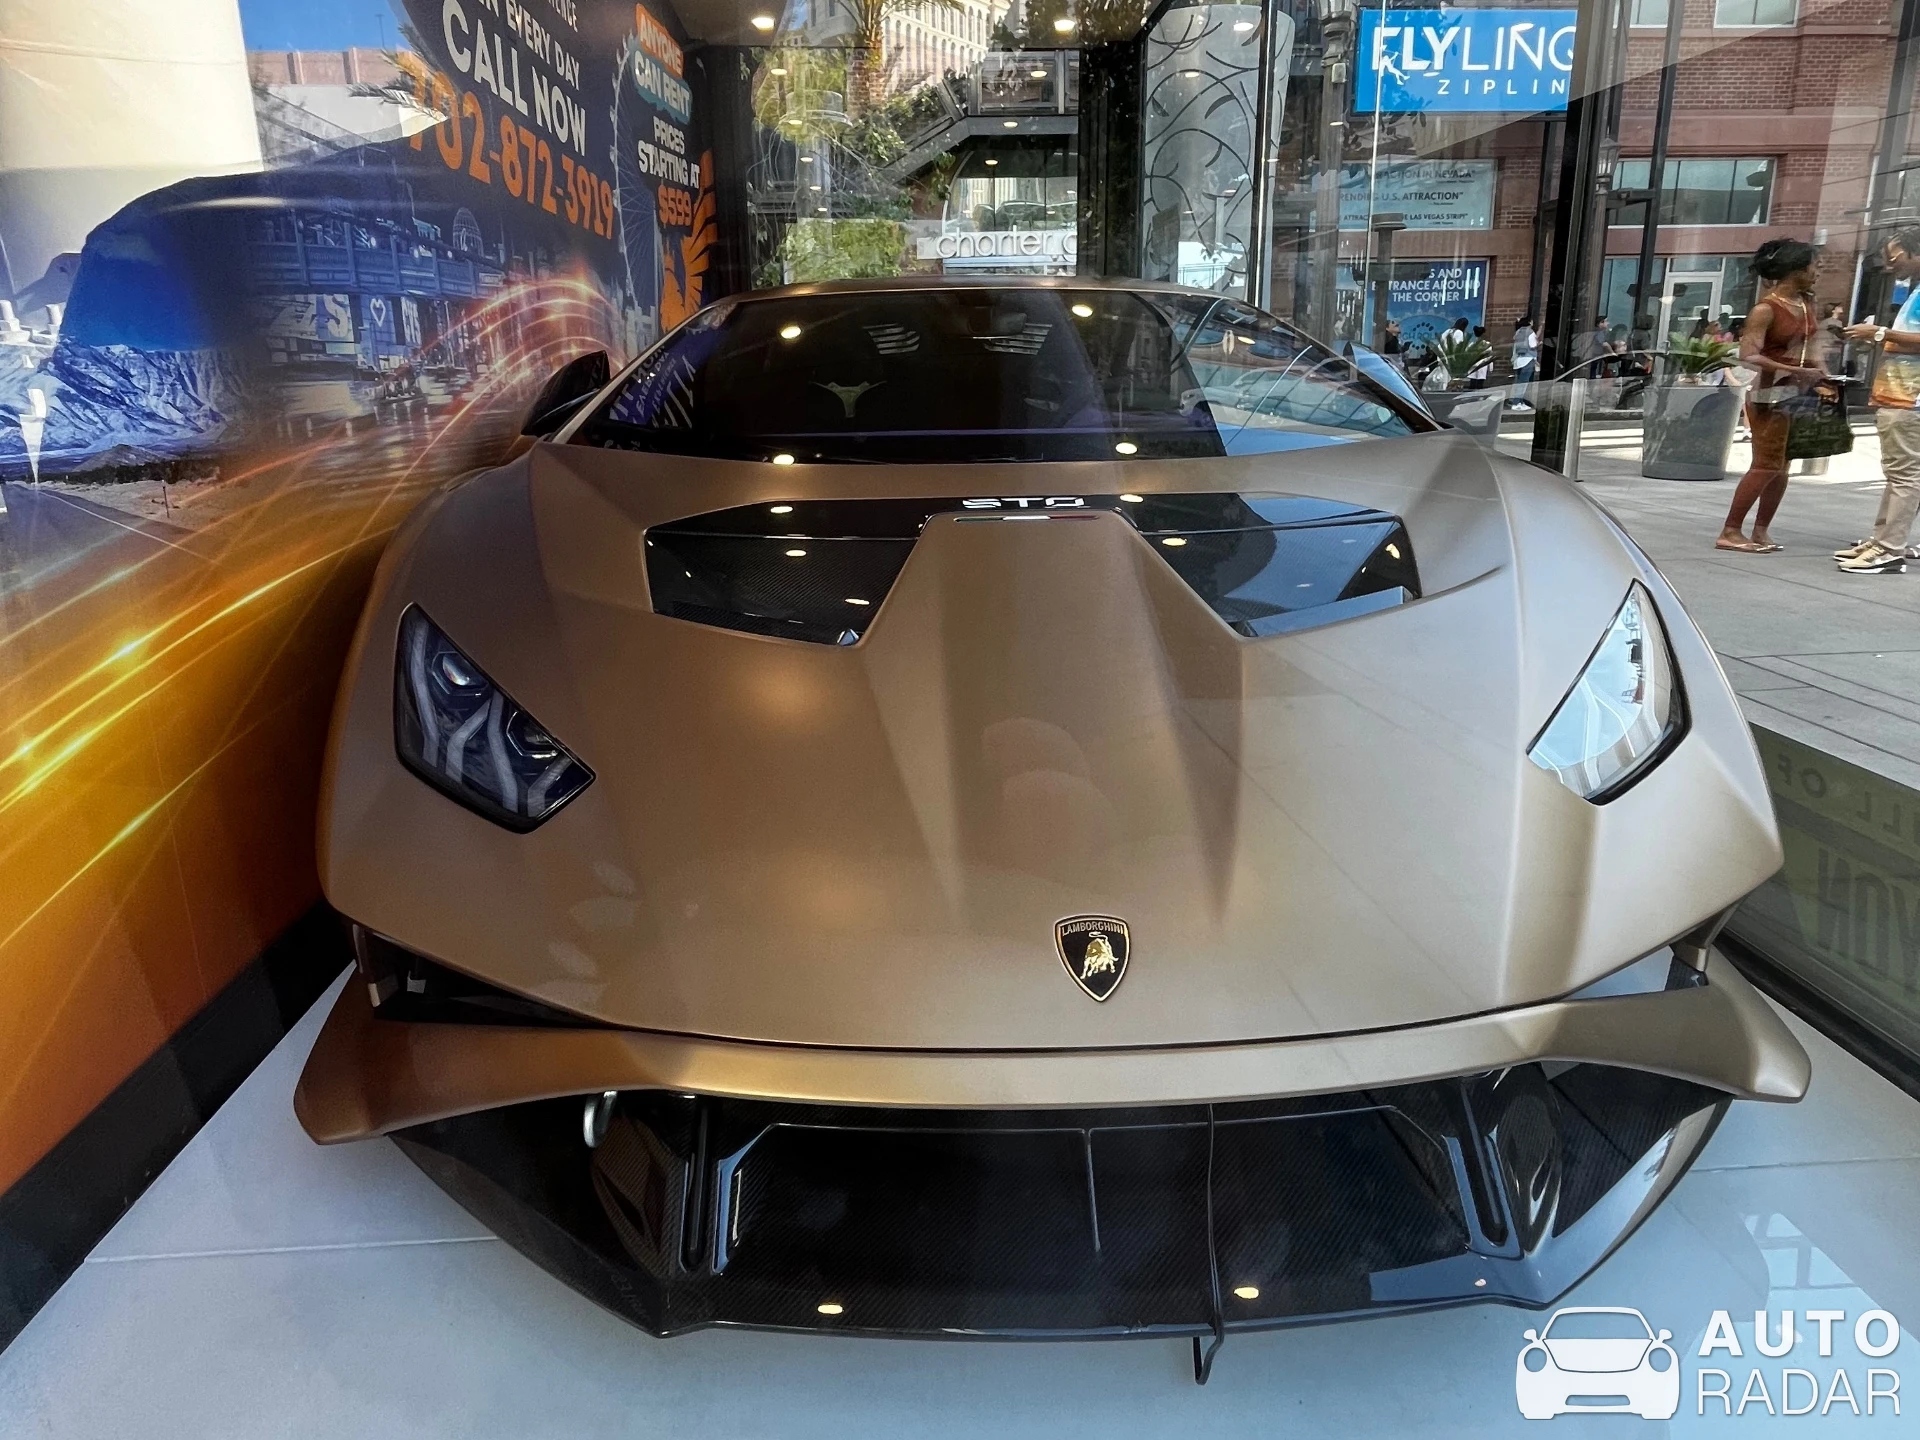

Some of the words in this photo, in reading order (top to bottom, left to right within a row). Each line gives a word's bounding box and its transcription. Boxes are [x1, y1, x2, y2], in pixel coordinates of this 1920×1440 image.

[505, 0, 550, 65] EVERY
[554, 40, 580, 91] DAY
[639, 13, 683, 76] ANYONE
[443, 0, 528, 116] CALL
[532, 66, 586, 156] NOW
[634, 50, 661, 97] CAN
[663, 75, 691, 118] RENT
[1437, 78, 1566, 95] ZIPLIN
[652, 116, 685, 155] PRICES
[637, 140, 689, 187] STARTING
[690, 162, 700, 189] AT
[936, 225, 1053, 258] charter
[1371, 280, 1430, 291] ETRANCE
[1437, 268, 1463, 279] AND
[1392, 292, 1412, 302] THE
[1061, 921, 1124, 937] LAMBORGHINI
